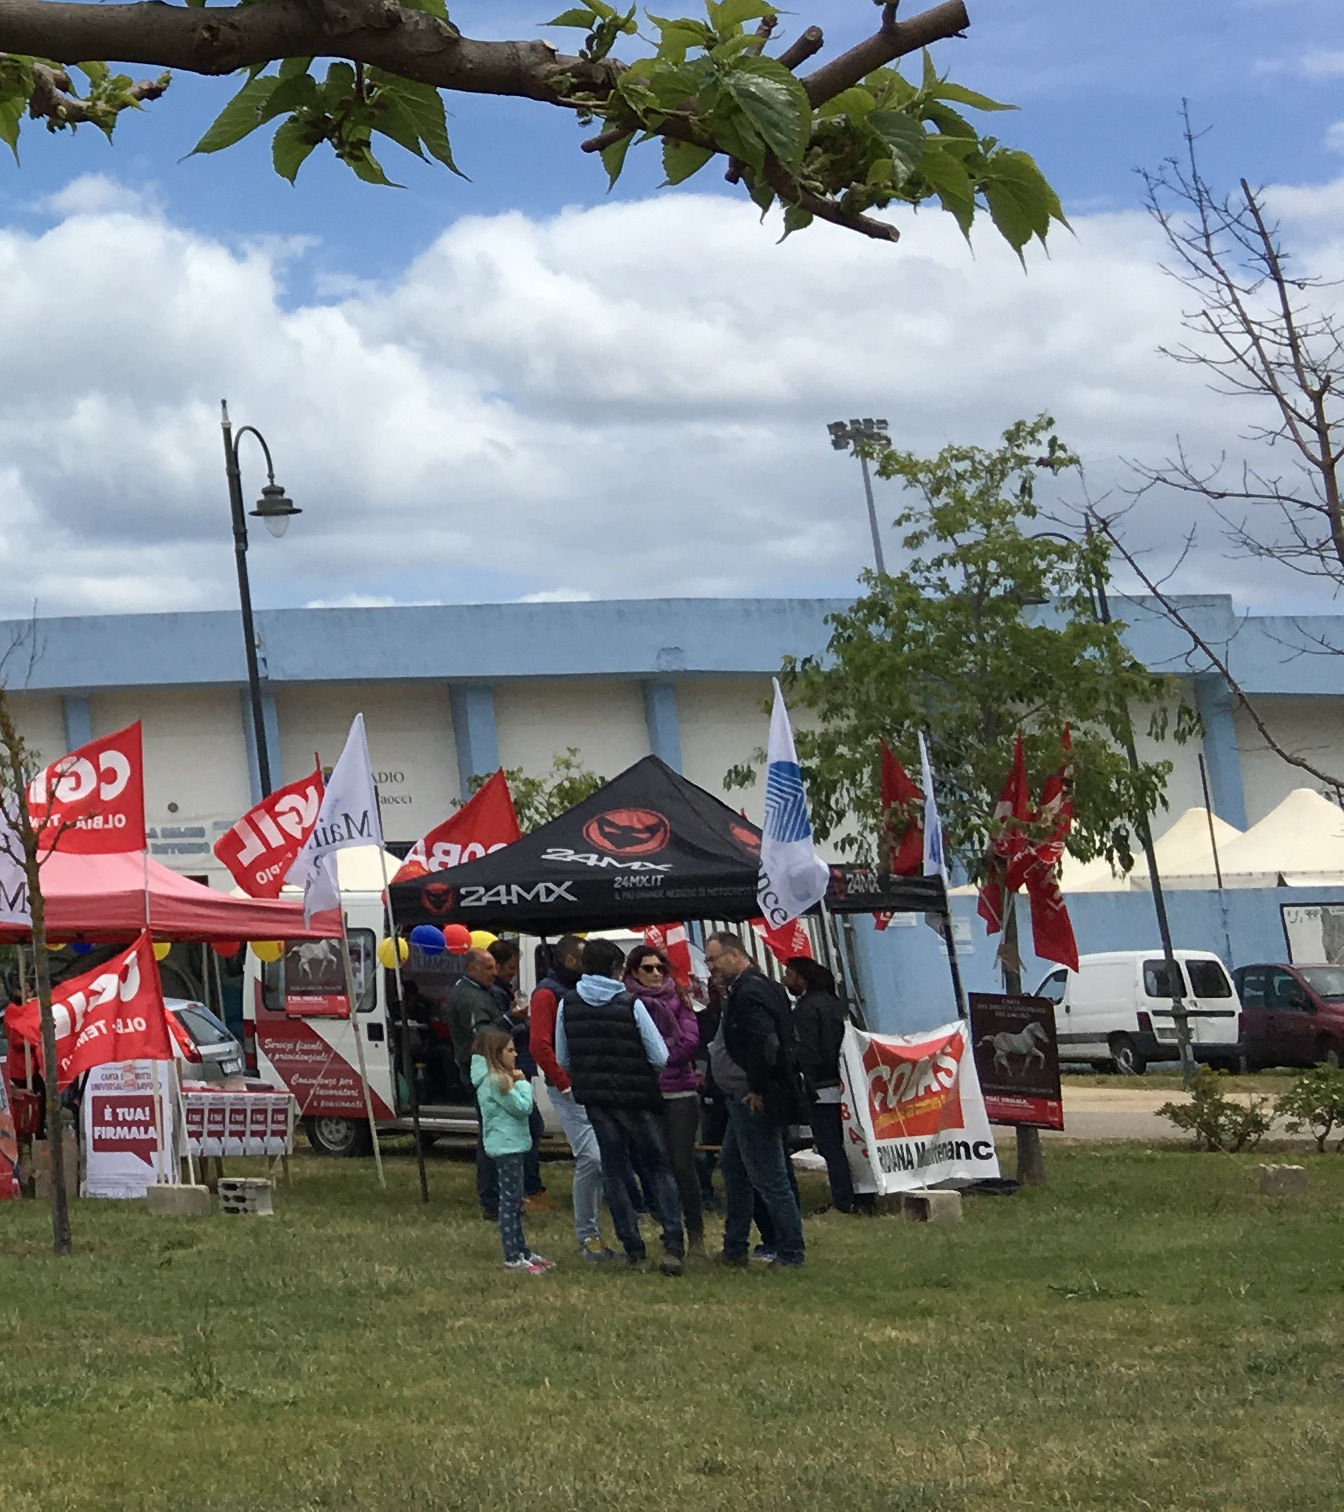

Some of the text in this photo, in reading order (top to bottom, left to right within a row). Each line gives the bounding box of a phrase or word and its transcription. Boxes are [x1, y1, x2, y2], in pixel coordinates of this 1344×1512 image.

[379, 795, 413, 804] aocci
[541, 848, 673, 871] 24MX
[459, 880, 578, 907] 24MX
[104, 1104, 150, 1121] È TUA!
